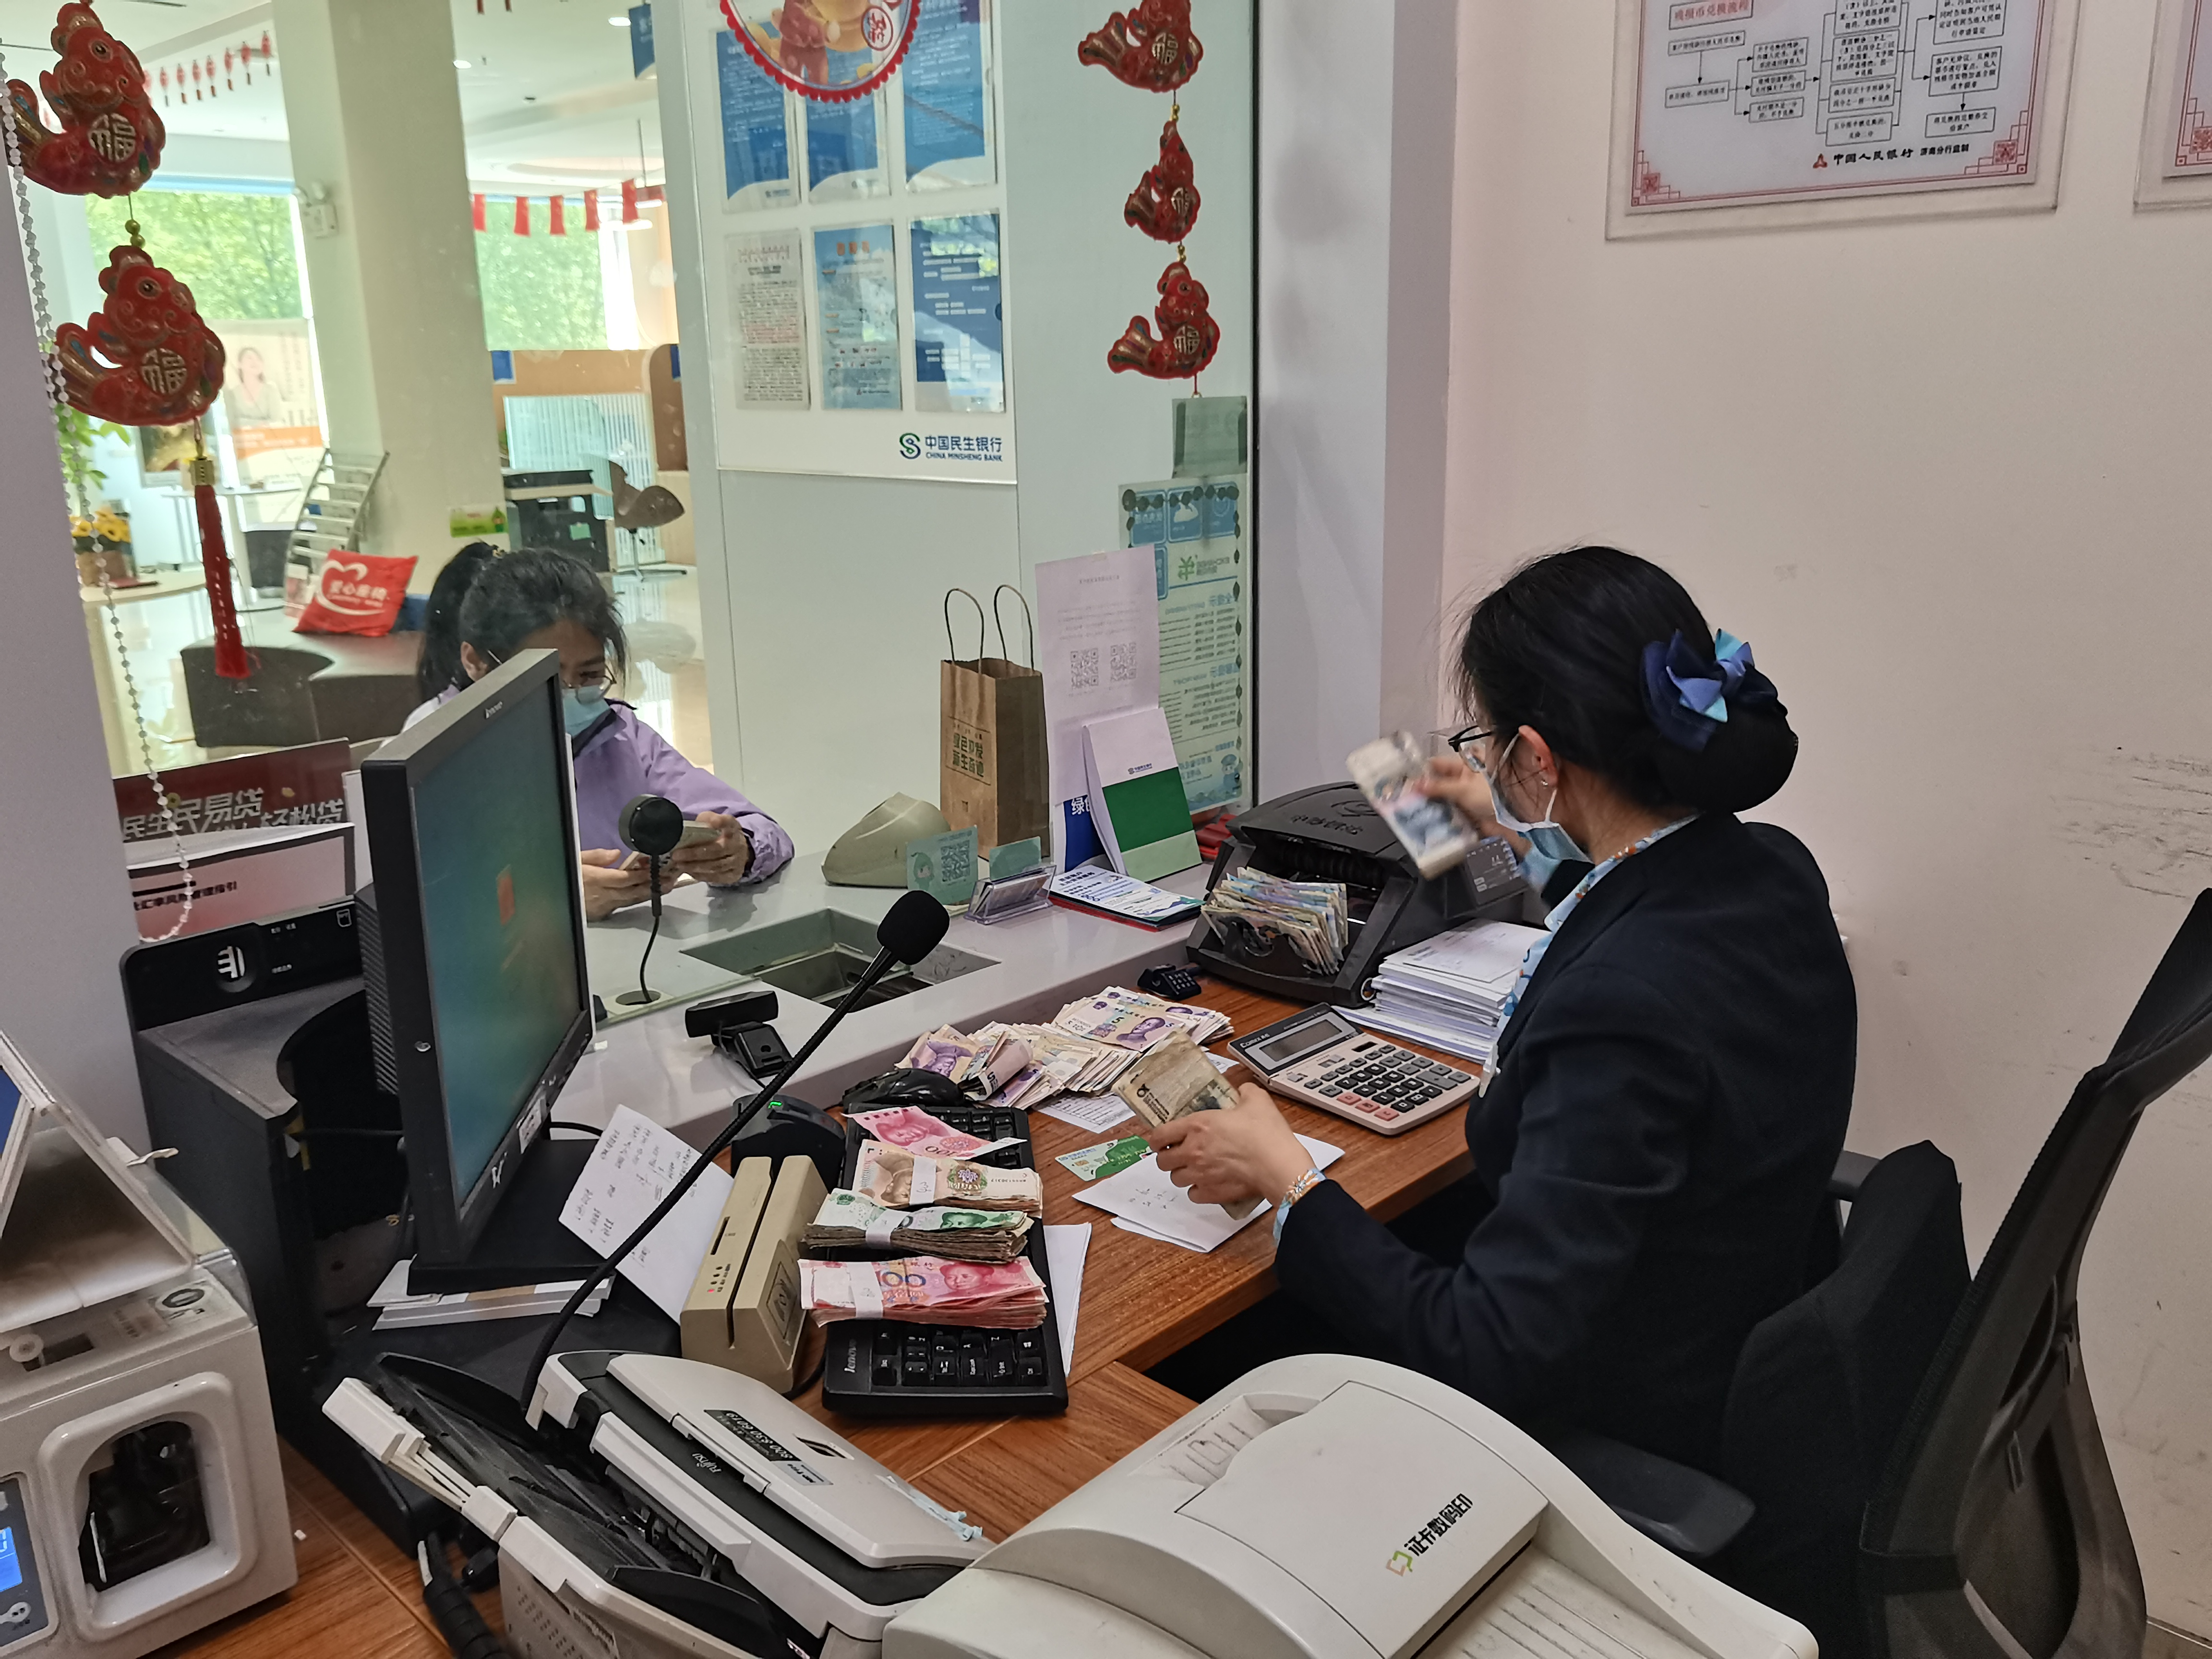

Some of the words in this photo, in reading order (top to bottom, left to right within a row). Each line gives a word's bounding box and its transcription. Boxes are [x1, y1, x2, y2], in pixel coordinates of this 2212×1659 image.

[1152, 32, 1178, 66] 福
[88, 113, 136, 163] 福
[1833, 148, 1914, 166] 中国人民银行
[1173, 325, 1200, 355] 福
[140, 348, 187, 394] 福
[925, 434, 1002, 453] 中国民生银行
[984, 454, 1003, 462] BANK
[692, 1453, 723, 1473] FUJITSU
